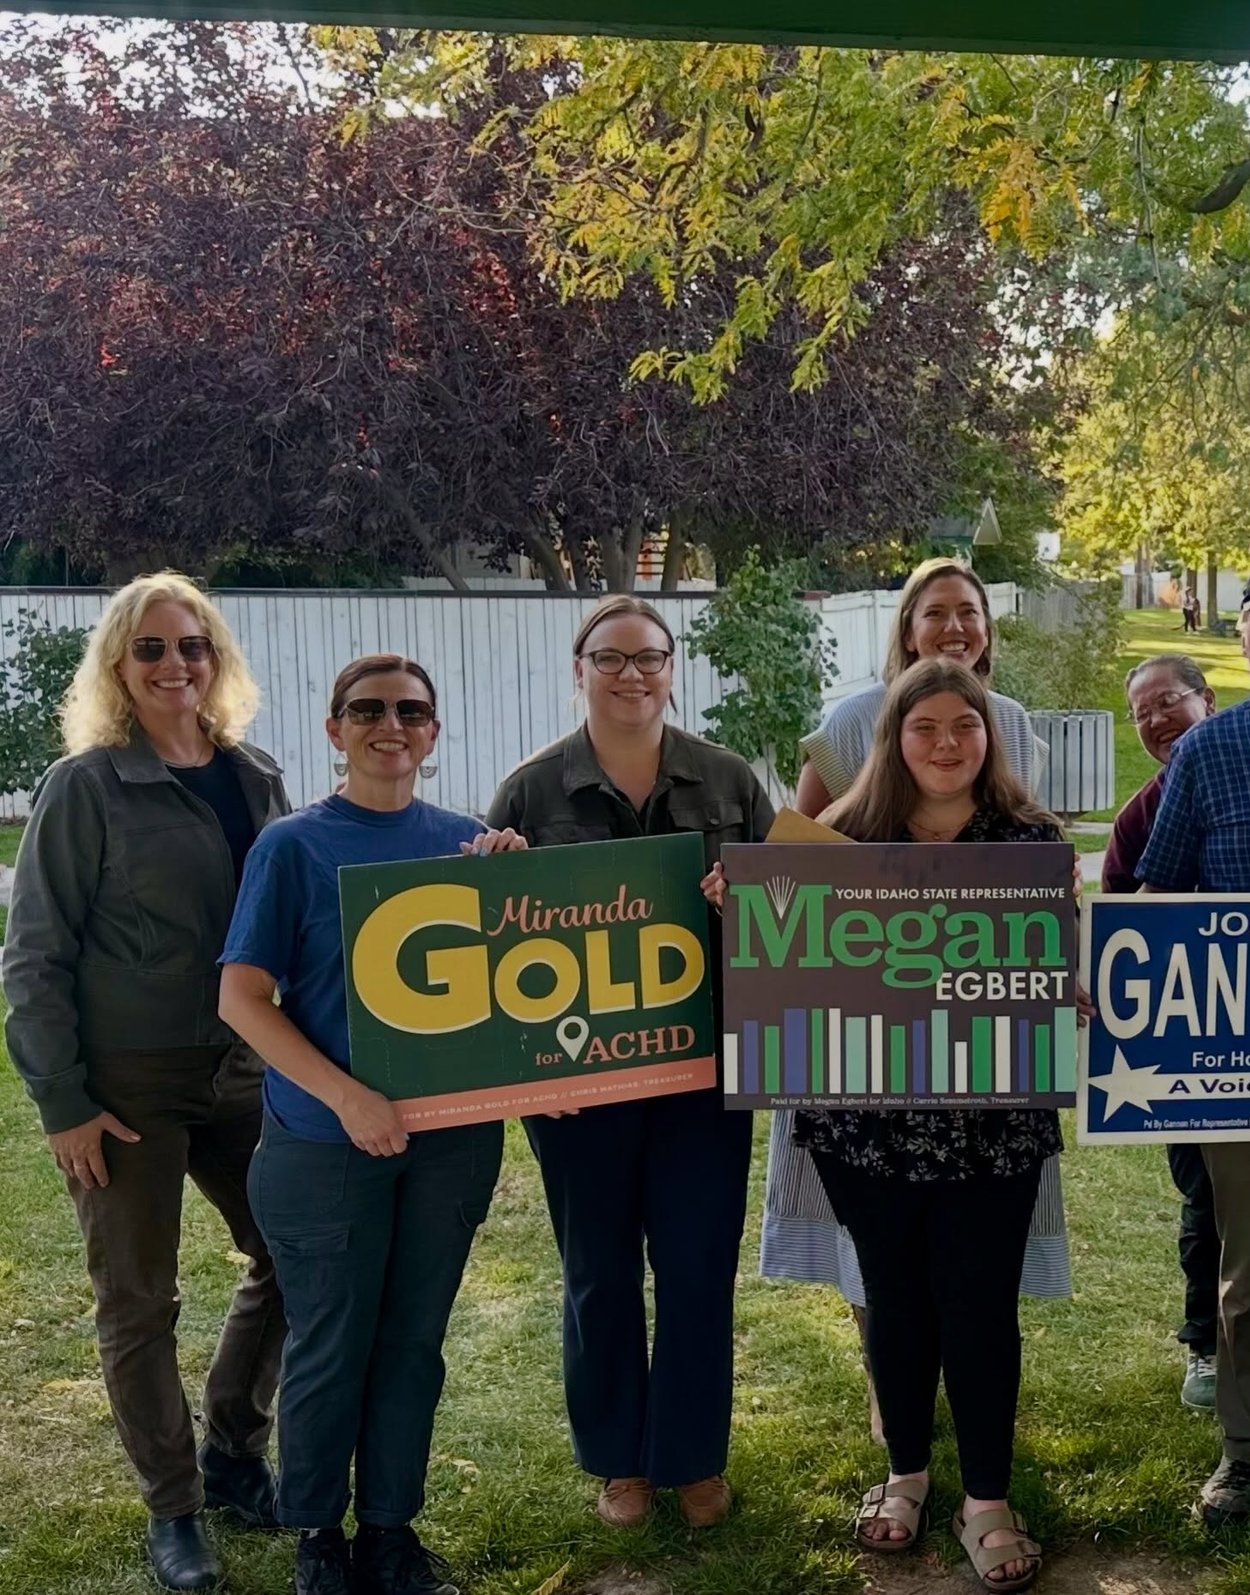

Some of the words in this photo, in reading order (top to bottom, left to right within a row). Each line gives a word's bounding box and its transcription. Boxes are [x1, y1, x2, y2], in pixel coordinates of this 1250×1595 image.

[835, 889, 873, 900] YOUR
[876, 888, 920, 899] IDAHO
[923, 888, 958, 899] STATE
[961, 887, 1065, 899] REPRESENTATIVE
[487, 884, 654, 936] Miranda
[728, 885, 1067, 988] Megan
[352, 884, 705, 1034] GOLD
[936, 971, 1069, 1001] EGBERT
[535, 1050, 563, 1067] for
[583, 1025, 695, 1065] ACHD
[1192, 1051, 1226, 1068] For
[439, 1104, 482, 1115] MIRANDA
[485, 1100, 510, 1109] GOLD
[512, 1098, 530, 1106] FOR
[570, 1087, 597, 1097] CHRIS
[644, 1073, 693, 1086] TREASURER
[770, 1097, 788, 1105] Paid
[789, 1097, 800, 1105] for
[802, 1098, 812, 1106] by
[814, 1097, 840, 1106] Megan
[841, 1097, 867, 1106] Egbert
[869, 1097, 880, 1105] for
[882, 1097, 905, 1105] Idaho
[913, 1096, 939, 1105] Carrie
[990, 1096, 1030, 1104] Treasurer
[1168, 1078, 1191, 1094] A
[1163, 1119, 1188, 1128] Gannon
[1189, 1118, 1200, 1128] For
[1202, 1118, 1248, 1129] Representative
